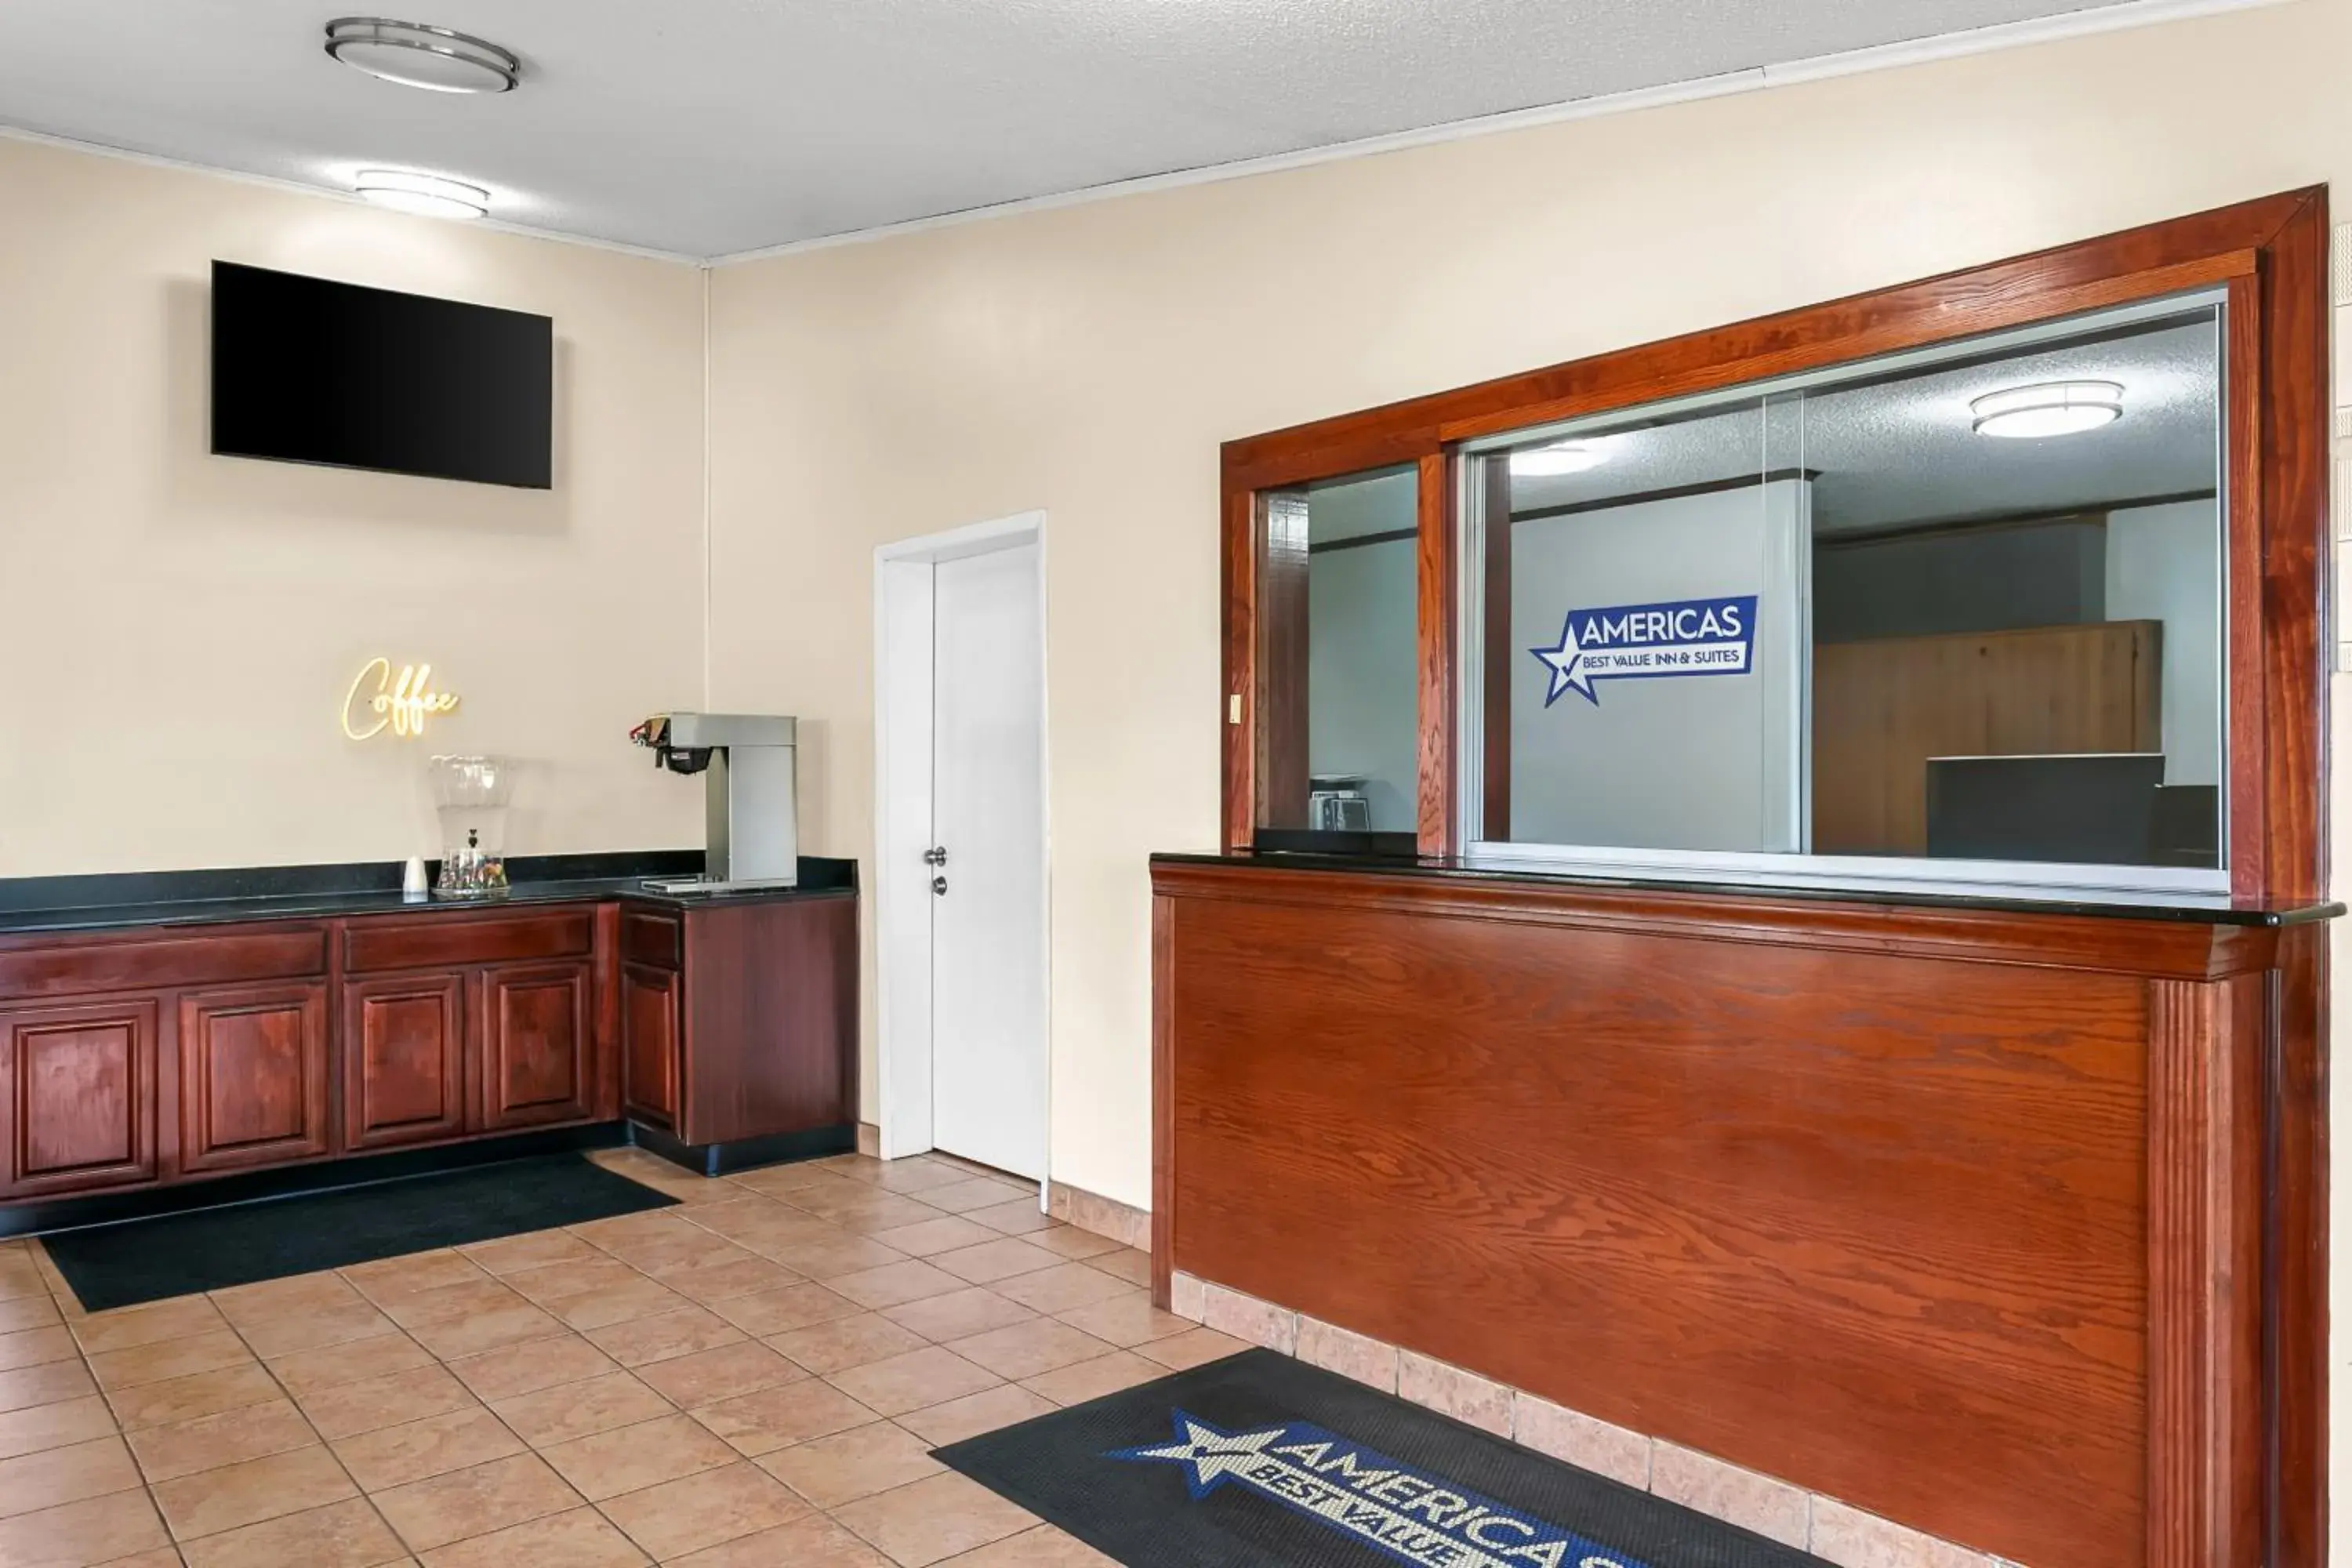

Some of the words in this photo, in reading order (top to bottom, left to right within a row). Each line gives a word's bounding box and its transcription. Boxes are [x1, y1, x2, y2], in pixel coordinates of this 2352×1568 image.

[1581, 604, 1742, 645] AMERICAS
[1583, 654, 1611, 668] BEST
[1613, 652, 1651, 666] VALUE
[1655, 652, 1679, 666] INN
[1680, 652, 1690, 665] &
[1694, 649, 1740, 665] SUITES
[341, 656, 460, 740] Coffee
[1247, 1463, 1344, 1508] BEST
[1342, 1503, 1466, 1566] VALUE
